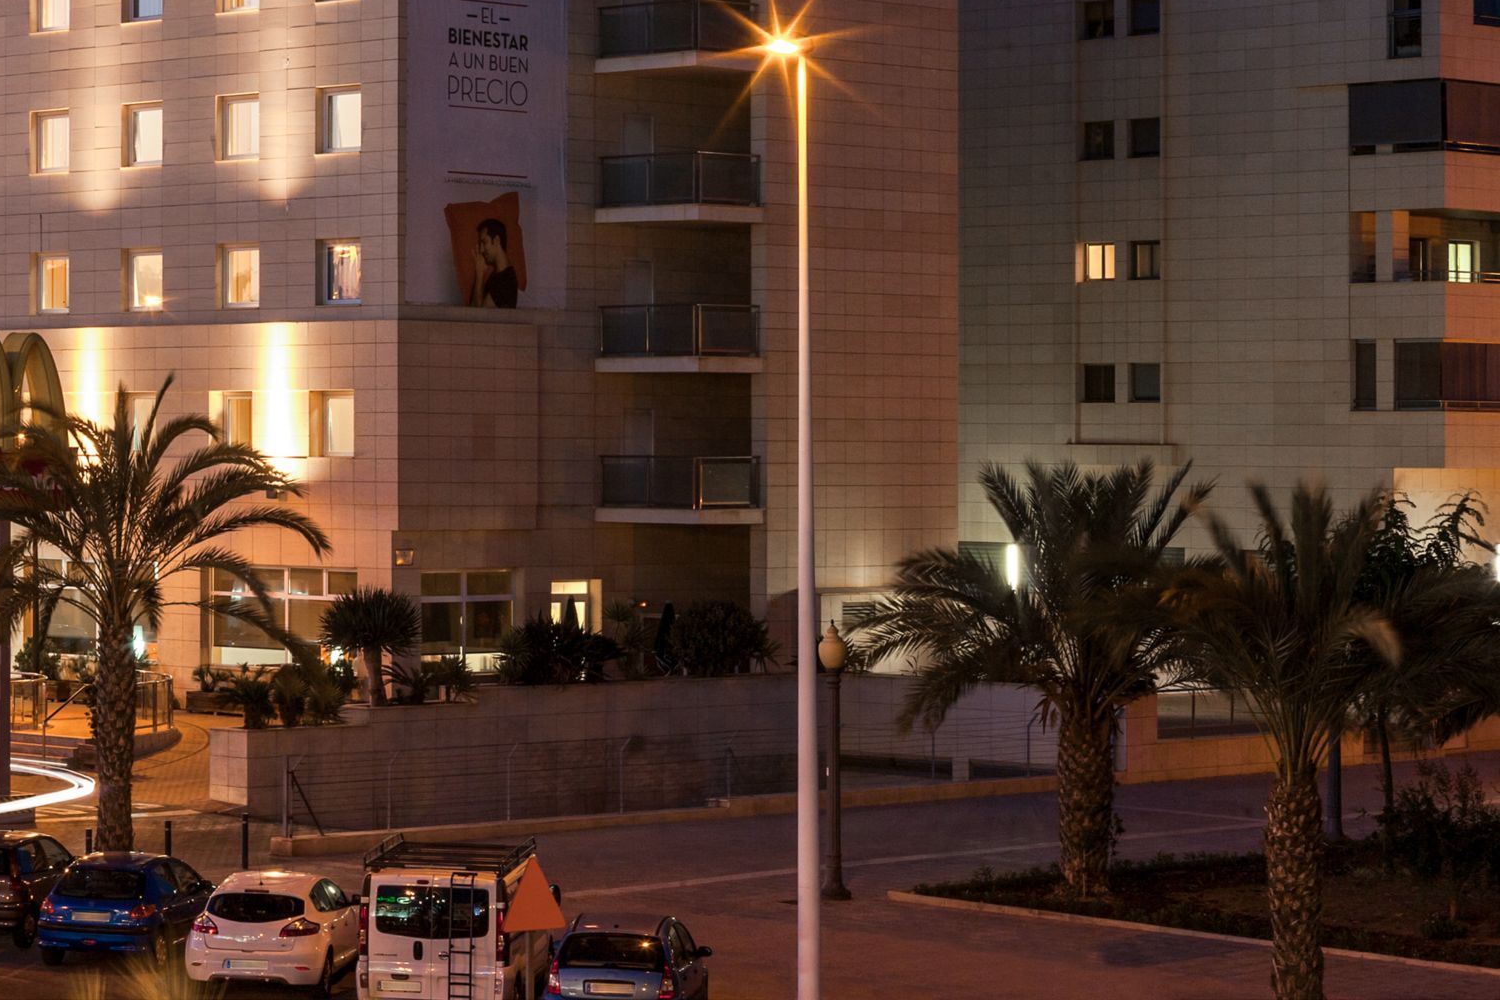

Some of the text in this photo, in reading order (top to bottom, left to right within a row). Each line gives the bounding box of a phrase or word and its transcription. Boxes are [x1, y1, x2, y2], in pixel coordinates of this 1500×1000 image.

[481, 7, 498, 25] EL
[448, 27, 529, 52] BIENESTAR
[448, 51, 529, 74] A UN BUEN
[447, 74, 529, 106] PRECIO
